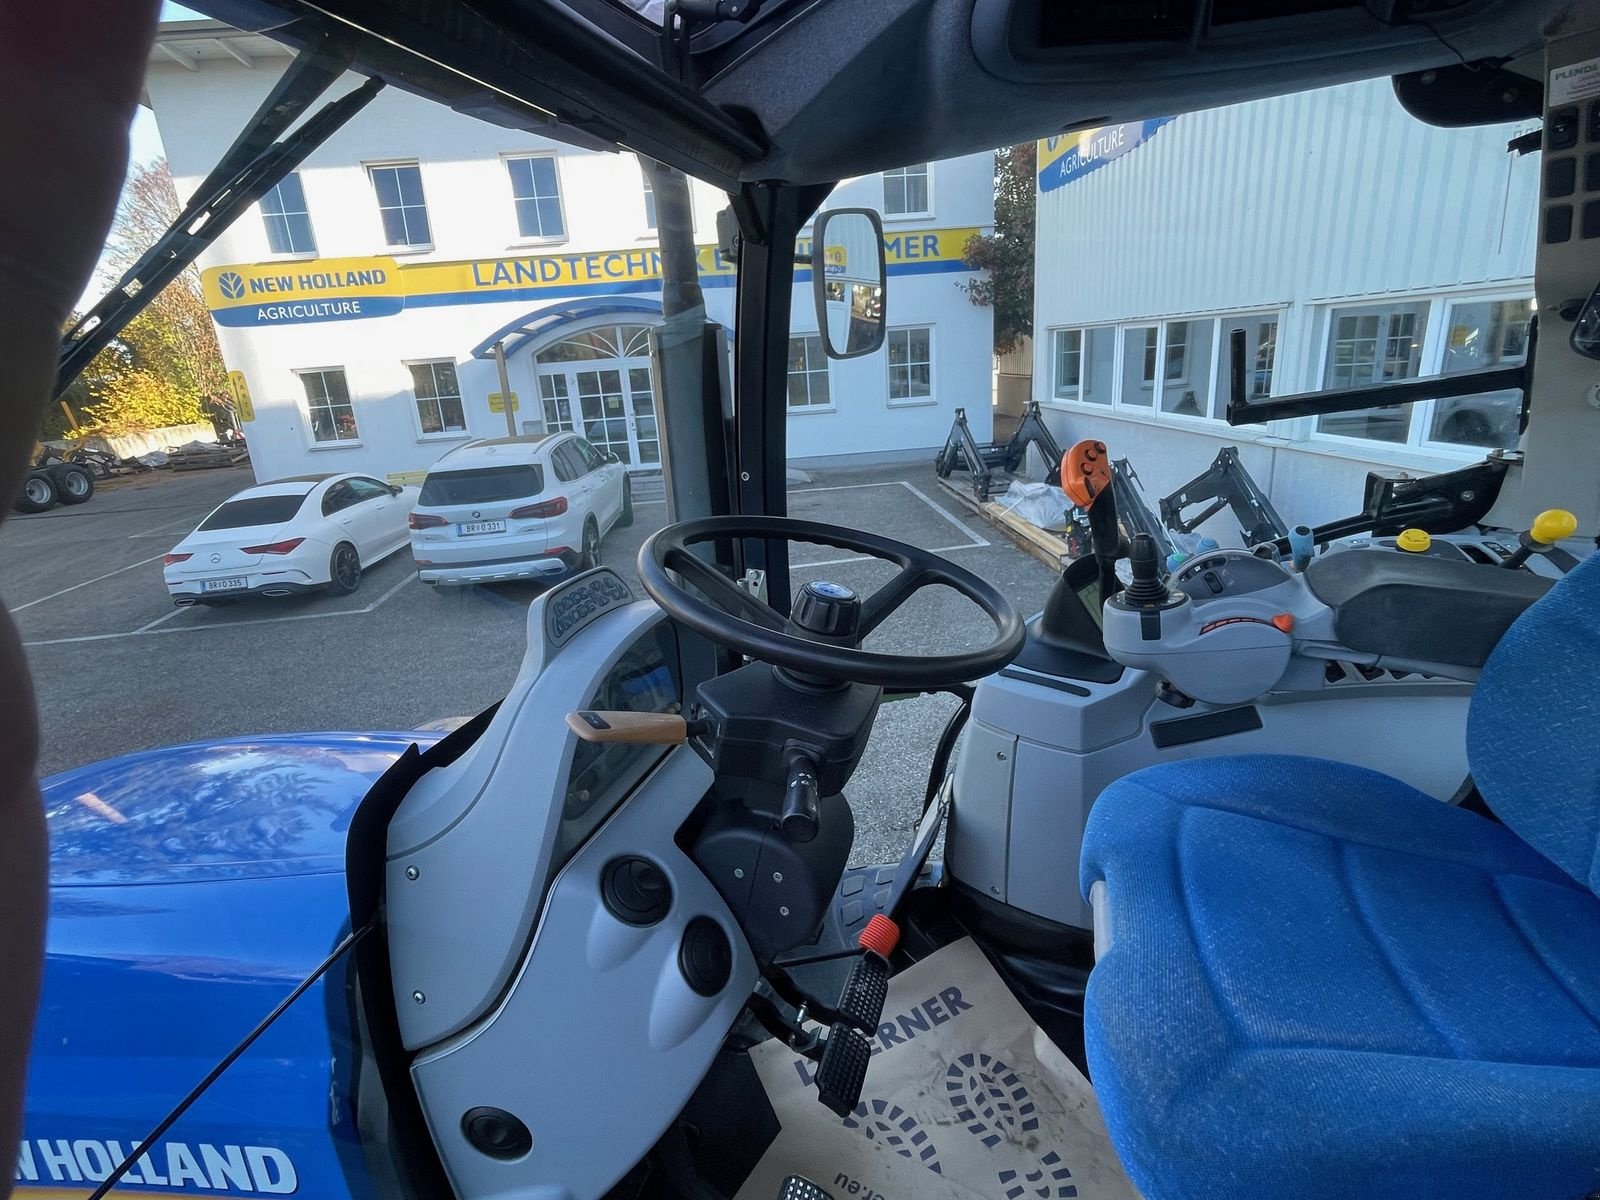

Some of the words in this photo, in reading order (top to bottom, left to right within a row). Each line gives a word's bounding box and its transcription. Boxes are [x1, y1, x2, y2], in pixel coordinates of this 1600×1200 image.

[1060, 126, 1124, 177] AGRICULTURE
[250, 275, 294, 294] NEW
[298, 269, 386, 290] HOLLAND
[257, 301, 361, 321] AGRICULTURE
[36, 1139, 298, 1195] HOLLAND
